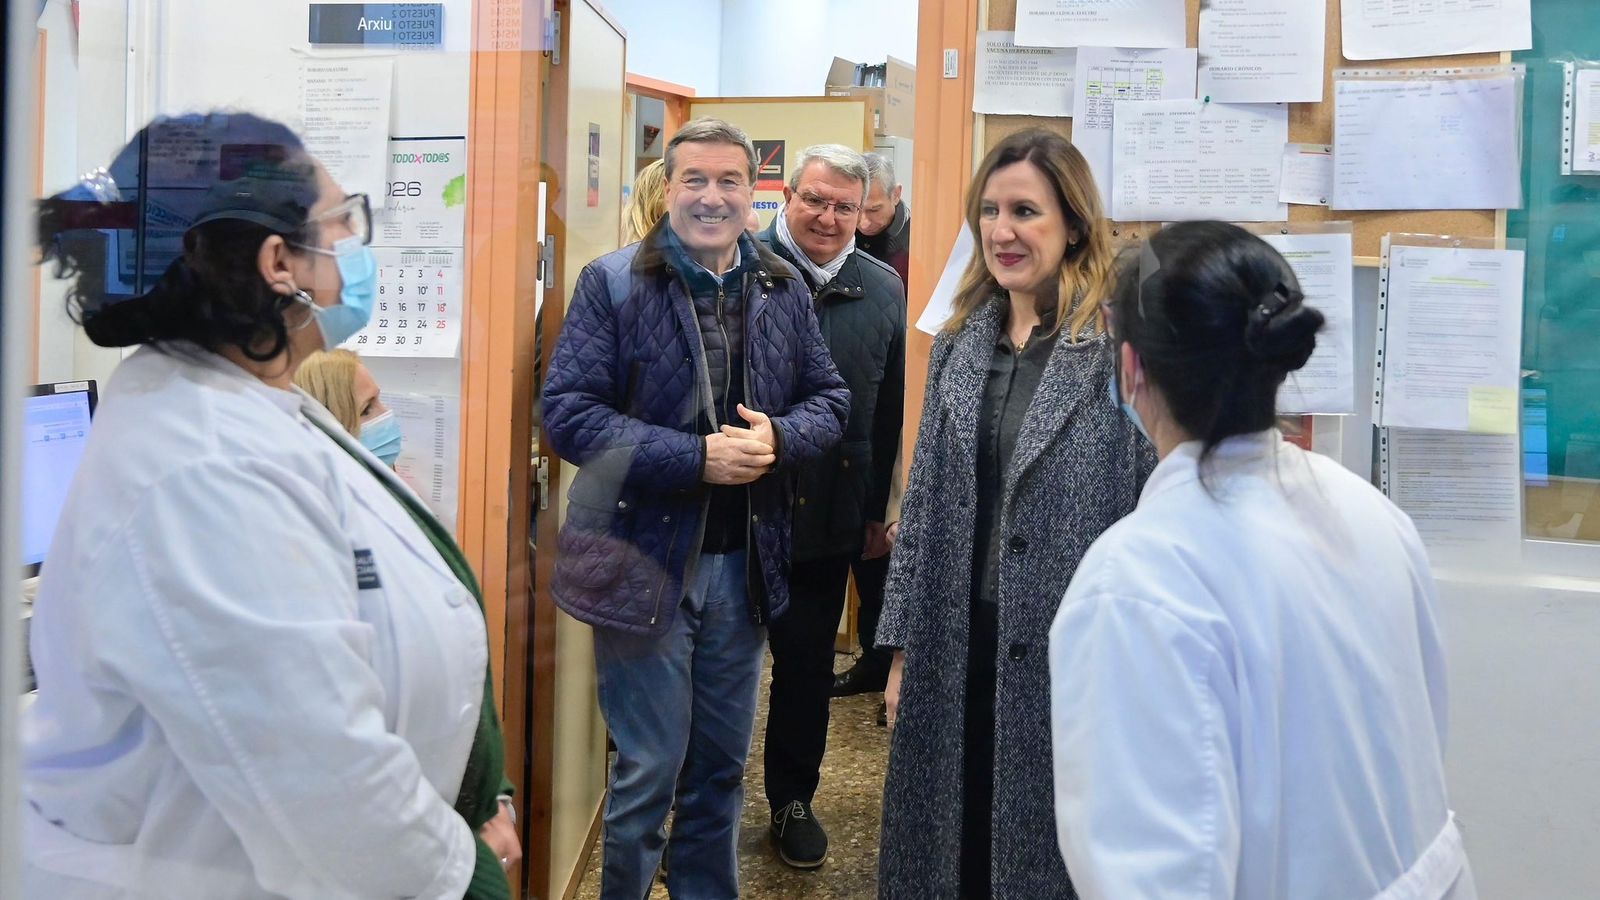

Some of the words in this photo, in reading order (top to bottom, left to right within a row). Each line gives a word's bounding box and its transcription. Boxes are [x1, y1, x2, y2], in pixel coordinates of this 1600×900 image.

[358, 16, 392, 31] Arxiu
[380, 269, 383, 277] 1
[399, 269, 404, 278] 2
[418, 269, 423, 278] 3
[437, 269, 443, 278] 4
[380, 286, 385, 294] 8
[399, 286, 404, 294] 9
[437, 286, 443, 295] 11
[380, 302, 387, 311] 15
[399, 303, 406, 311] 16
[418, 303, 426, 312] 17
[379, 319, 388, 328] 22
[398, 320, 407, 328] 23
[417, 320, 427, 328] 24
[436, 320, 446, 329] 25
[358, 336, 368, 344] 28
[377, 336, 386, 344] 29
[396, 336, 406, 345] 30
[414, 336, 422, 345] 31
